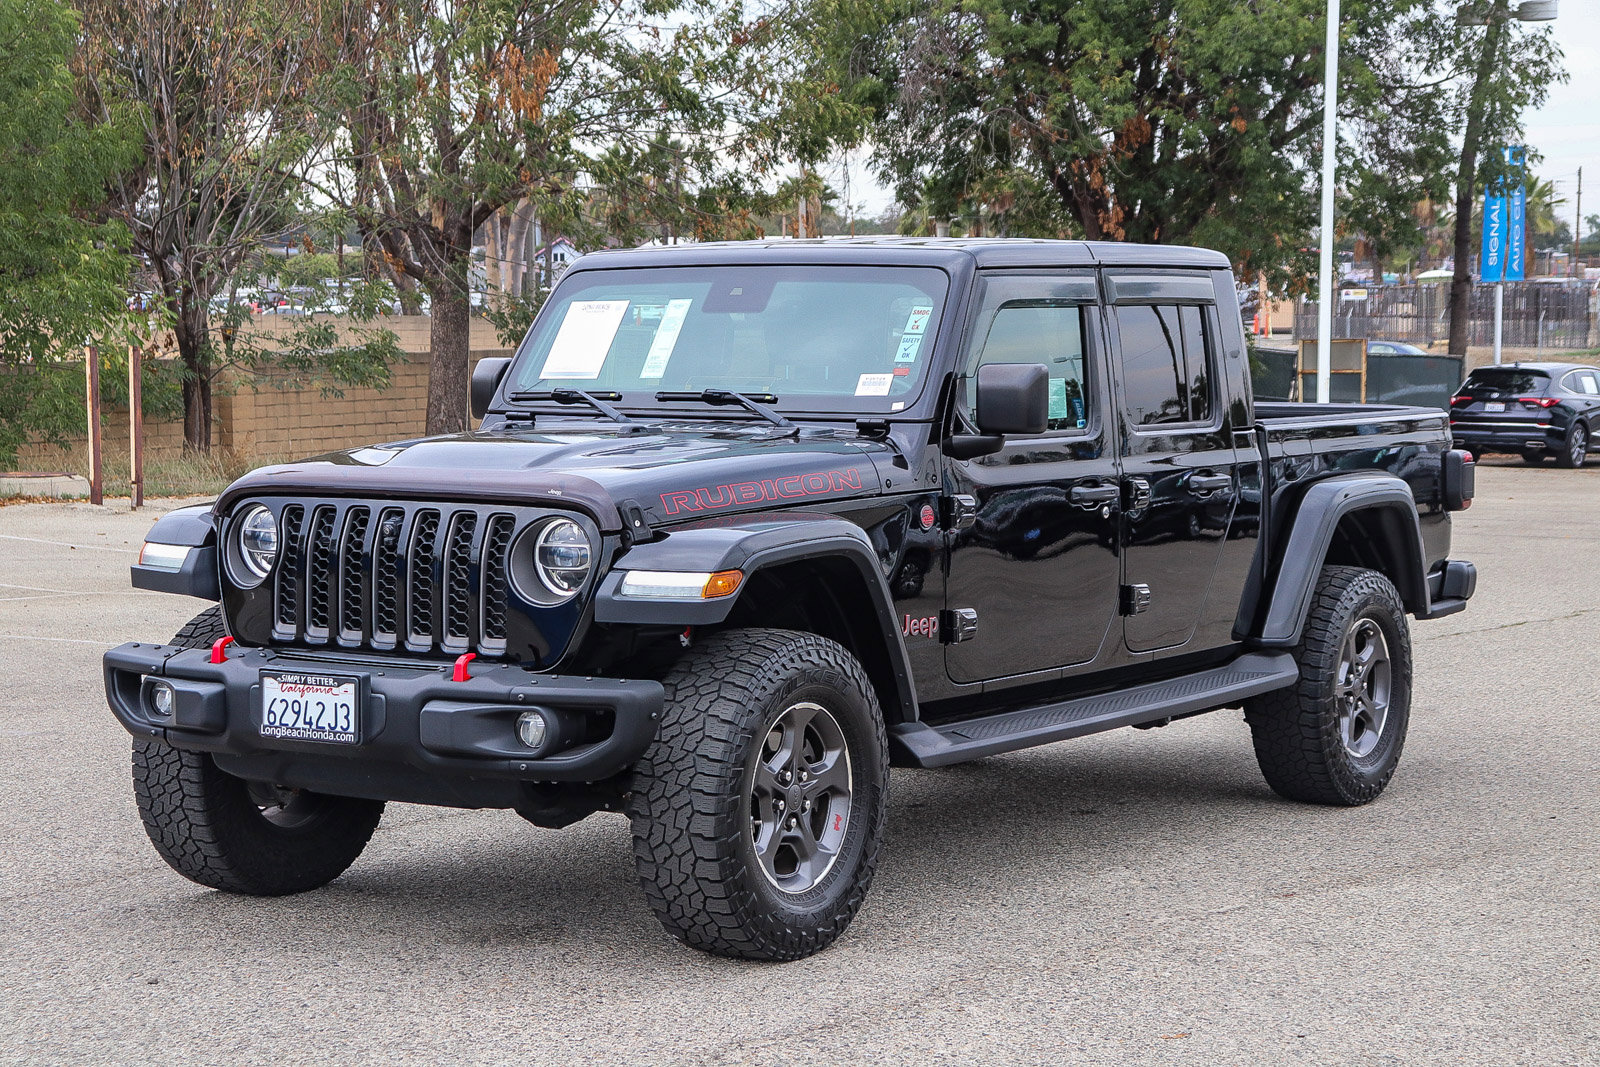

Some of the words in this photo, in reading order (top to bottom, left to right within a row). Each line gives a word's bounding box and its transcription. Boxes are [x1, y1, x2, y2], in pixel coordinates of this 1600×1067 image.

[1488, 200, 1501, 266] SIGNAL
[1511, 224, 1522, 272] AUTO
[659, 468, 862, 515] RUBICON
[901, 614, 939, 639] Jeep
[280, 674, 306, 684] SIMPLY
[307, 676, 334, 686] BETTER
[280, 682, 340, 698] California
[267, 697, 351, 732] 62942J3
[260, 724, 354, 742] LongBeachHonda.com
